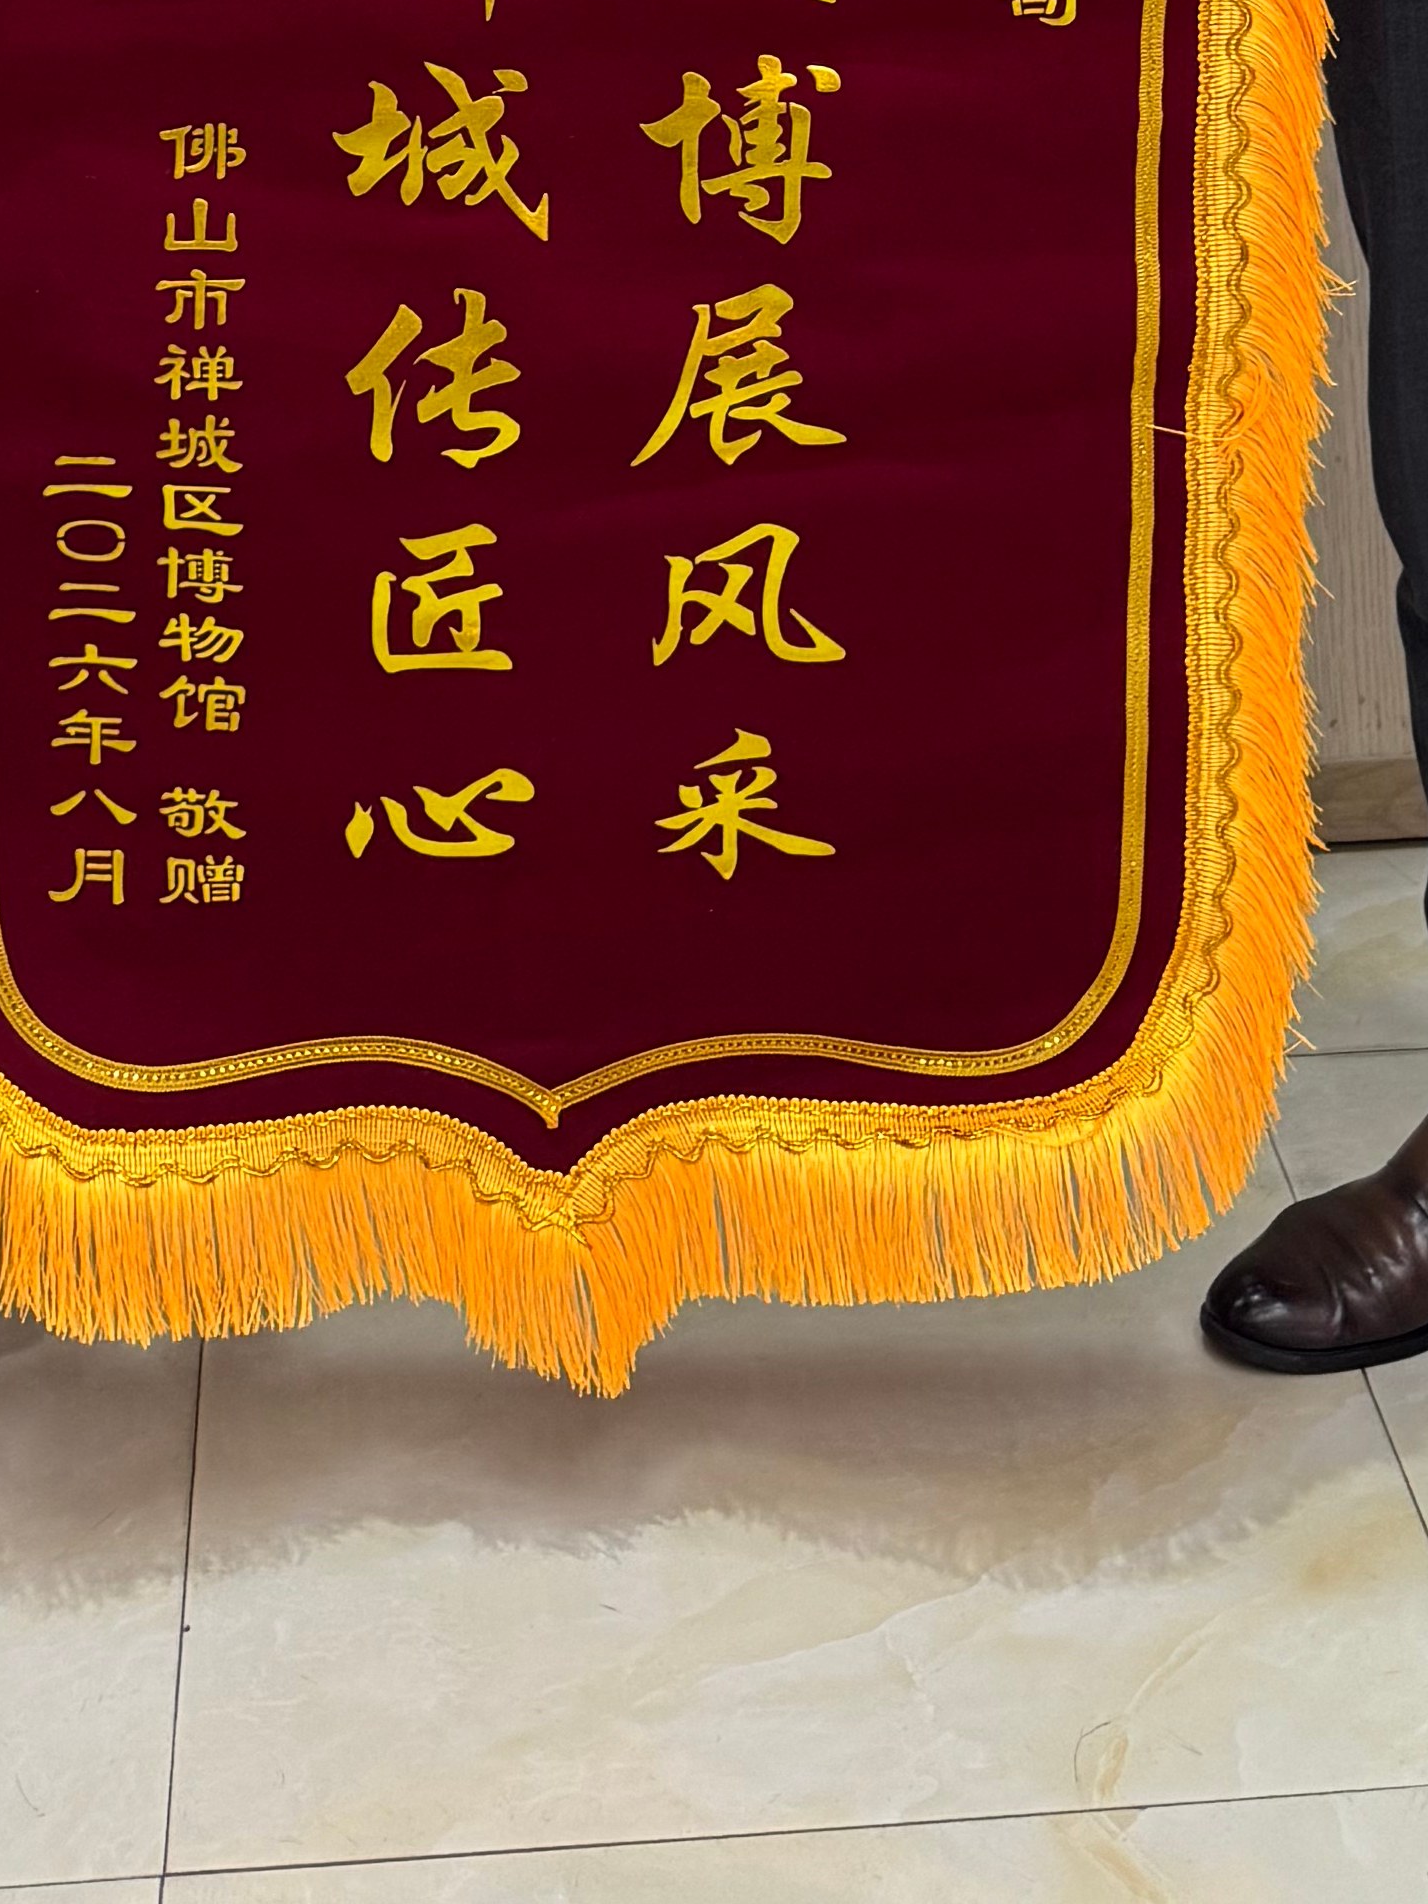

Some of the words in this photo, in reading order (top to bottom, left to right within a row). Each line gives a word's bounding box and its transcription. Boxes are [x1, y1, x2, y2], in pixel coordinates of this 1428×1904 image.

[154, 122, 247, 733] 佛山市禅城区博物馆
[158, 786, 247, 906] 敬赠
